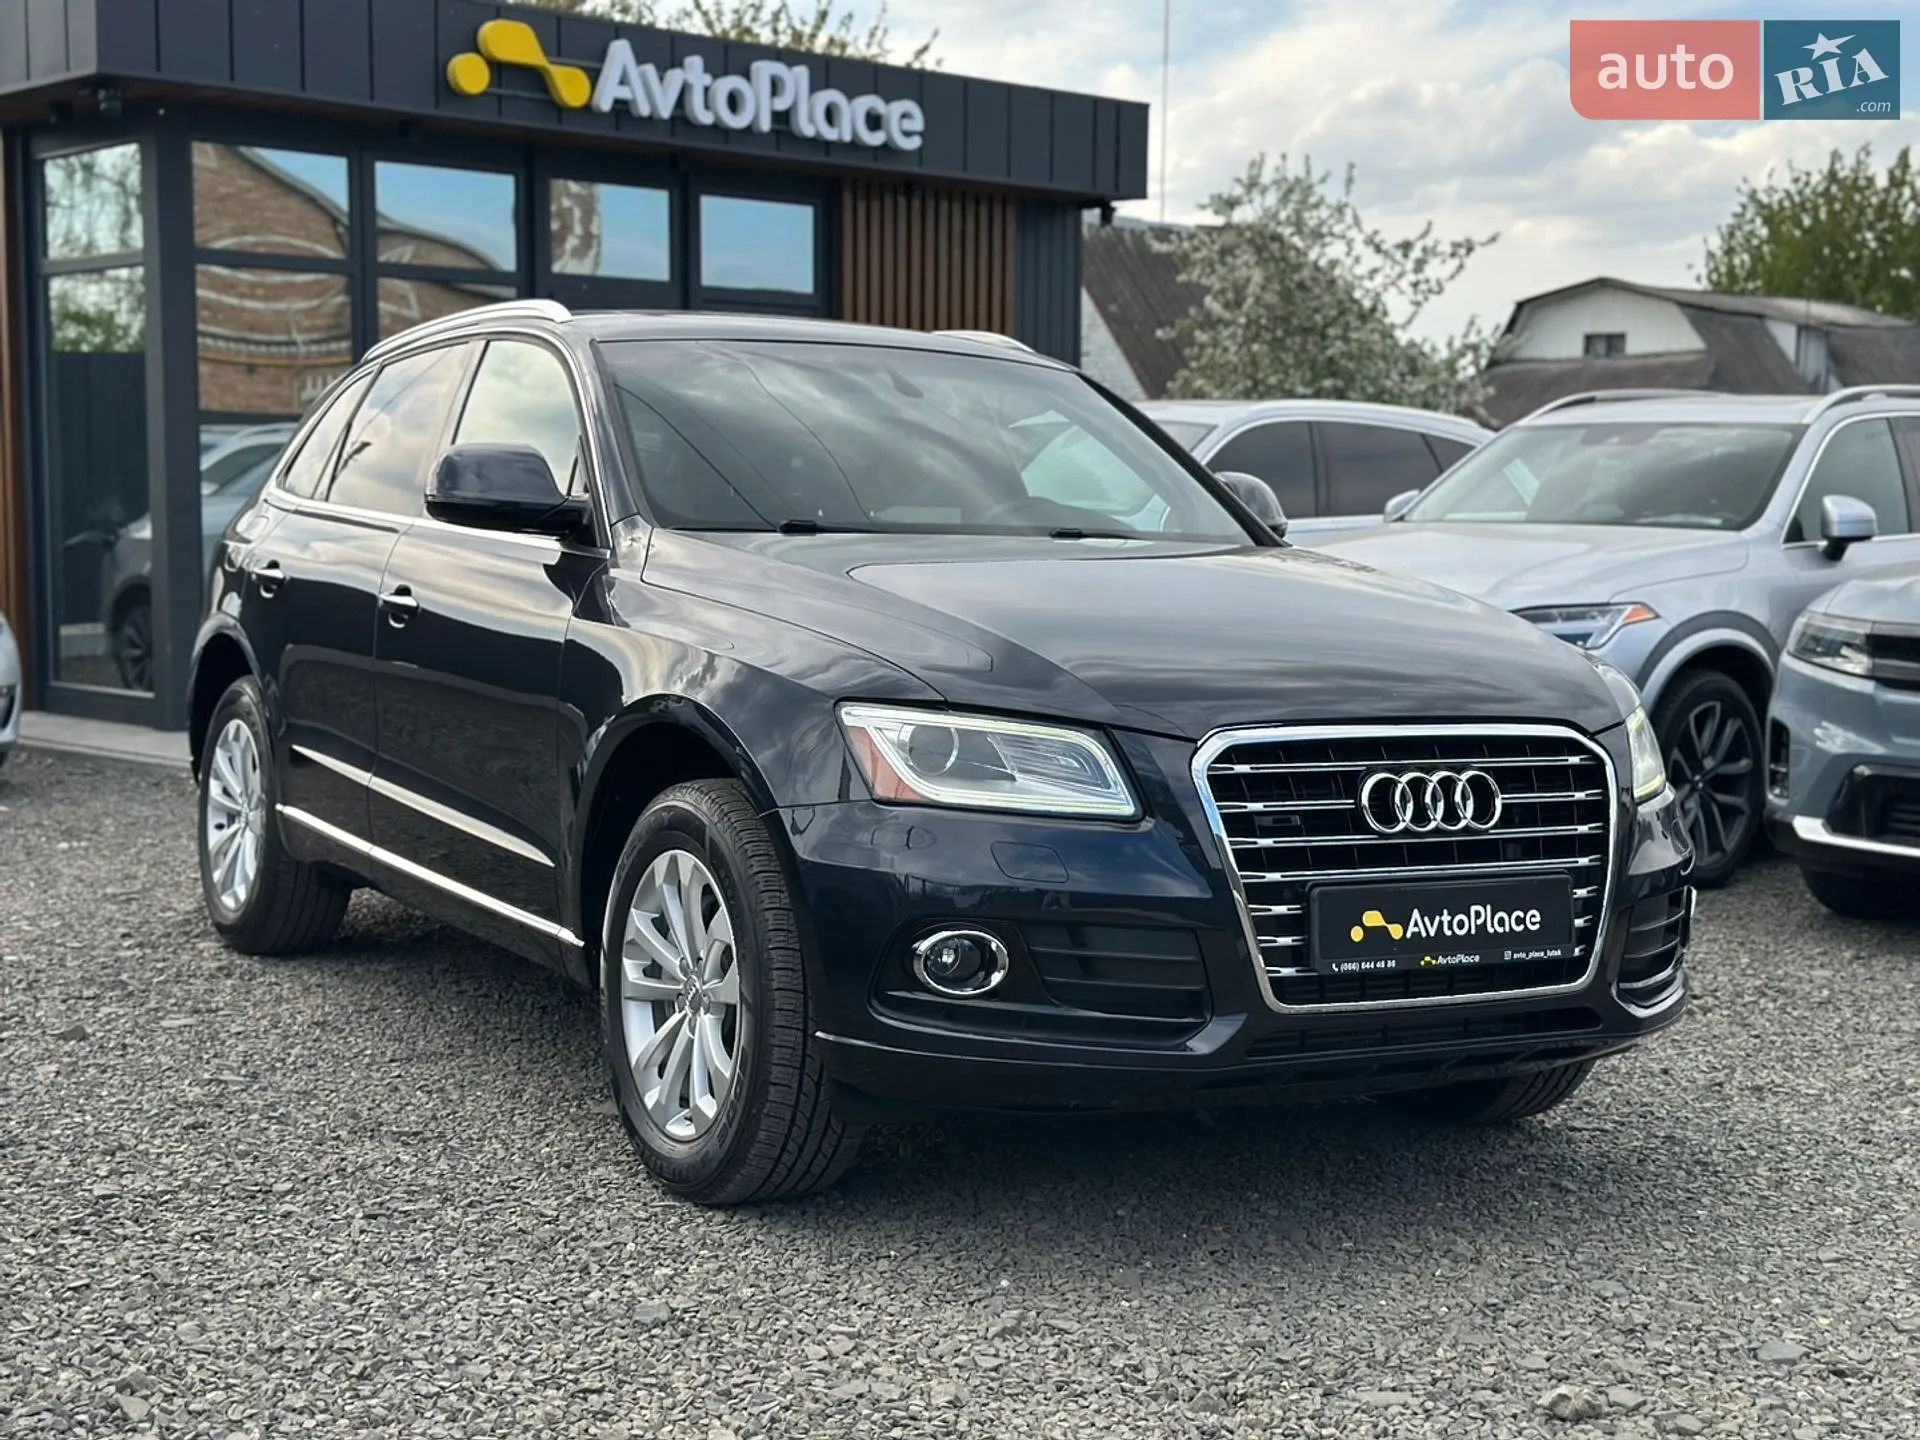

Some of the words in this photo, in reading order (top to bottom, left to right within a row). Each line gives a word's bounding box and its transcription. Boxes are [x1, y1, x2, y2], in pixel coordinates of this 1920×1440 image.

[591, 37, 925, 152] AvtoPlace
[1406, 903, 1542, 940] AvtoPlace
[1361, 961, 1375, 970] 644
[1437, 953, 1481, 965] AvtoPlace
